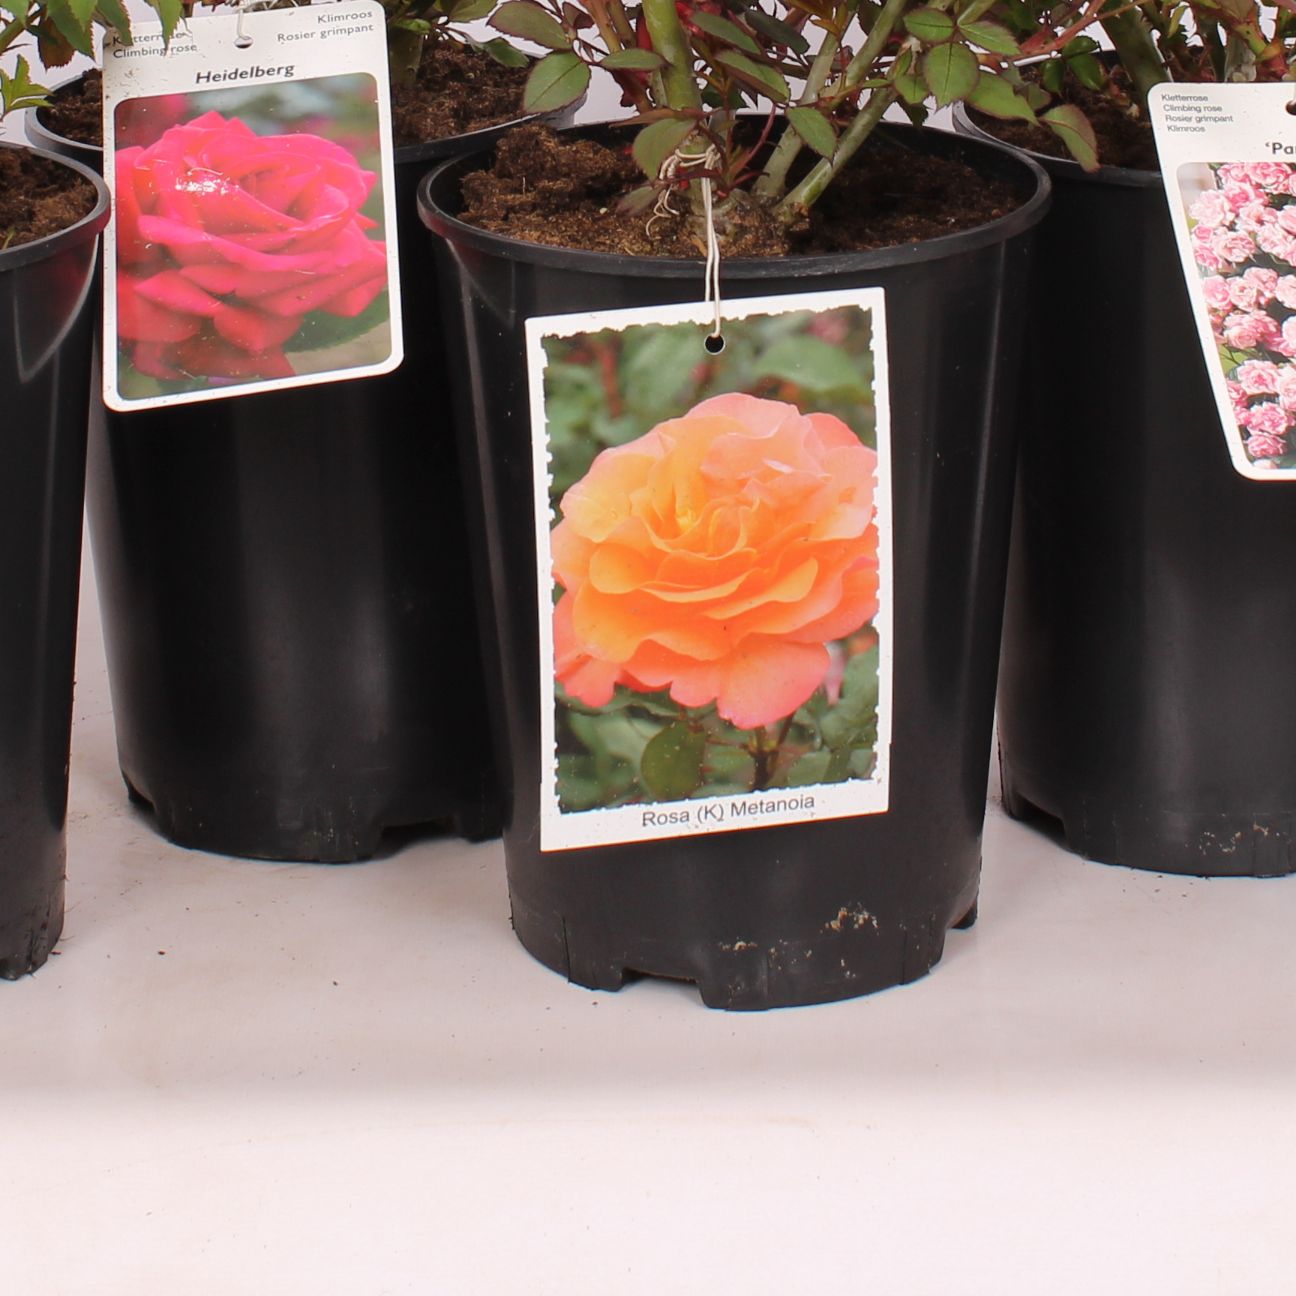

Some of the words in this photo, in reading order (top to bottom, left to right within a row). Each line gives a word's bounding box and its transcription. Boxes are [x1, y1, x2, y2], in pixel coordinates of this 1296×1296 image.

[317, 11, 373, 24] Klimroos
[277, 30, 316, 42] Rosier
[320, 24, 374, 39] grimpant
[170, 44, 197, 54] rose
[196, 65, 295, 84] Heidelberg
[1163, 104, 1202, 113] Climbing
[1195, 115, 1233, 123] grimpant
[642, 810, 690, 827] Rosa
[697, 803, 724, 823] (K)
[730, 794, 815, 817] Metanoia
